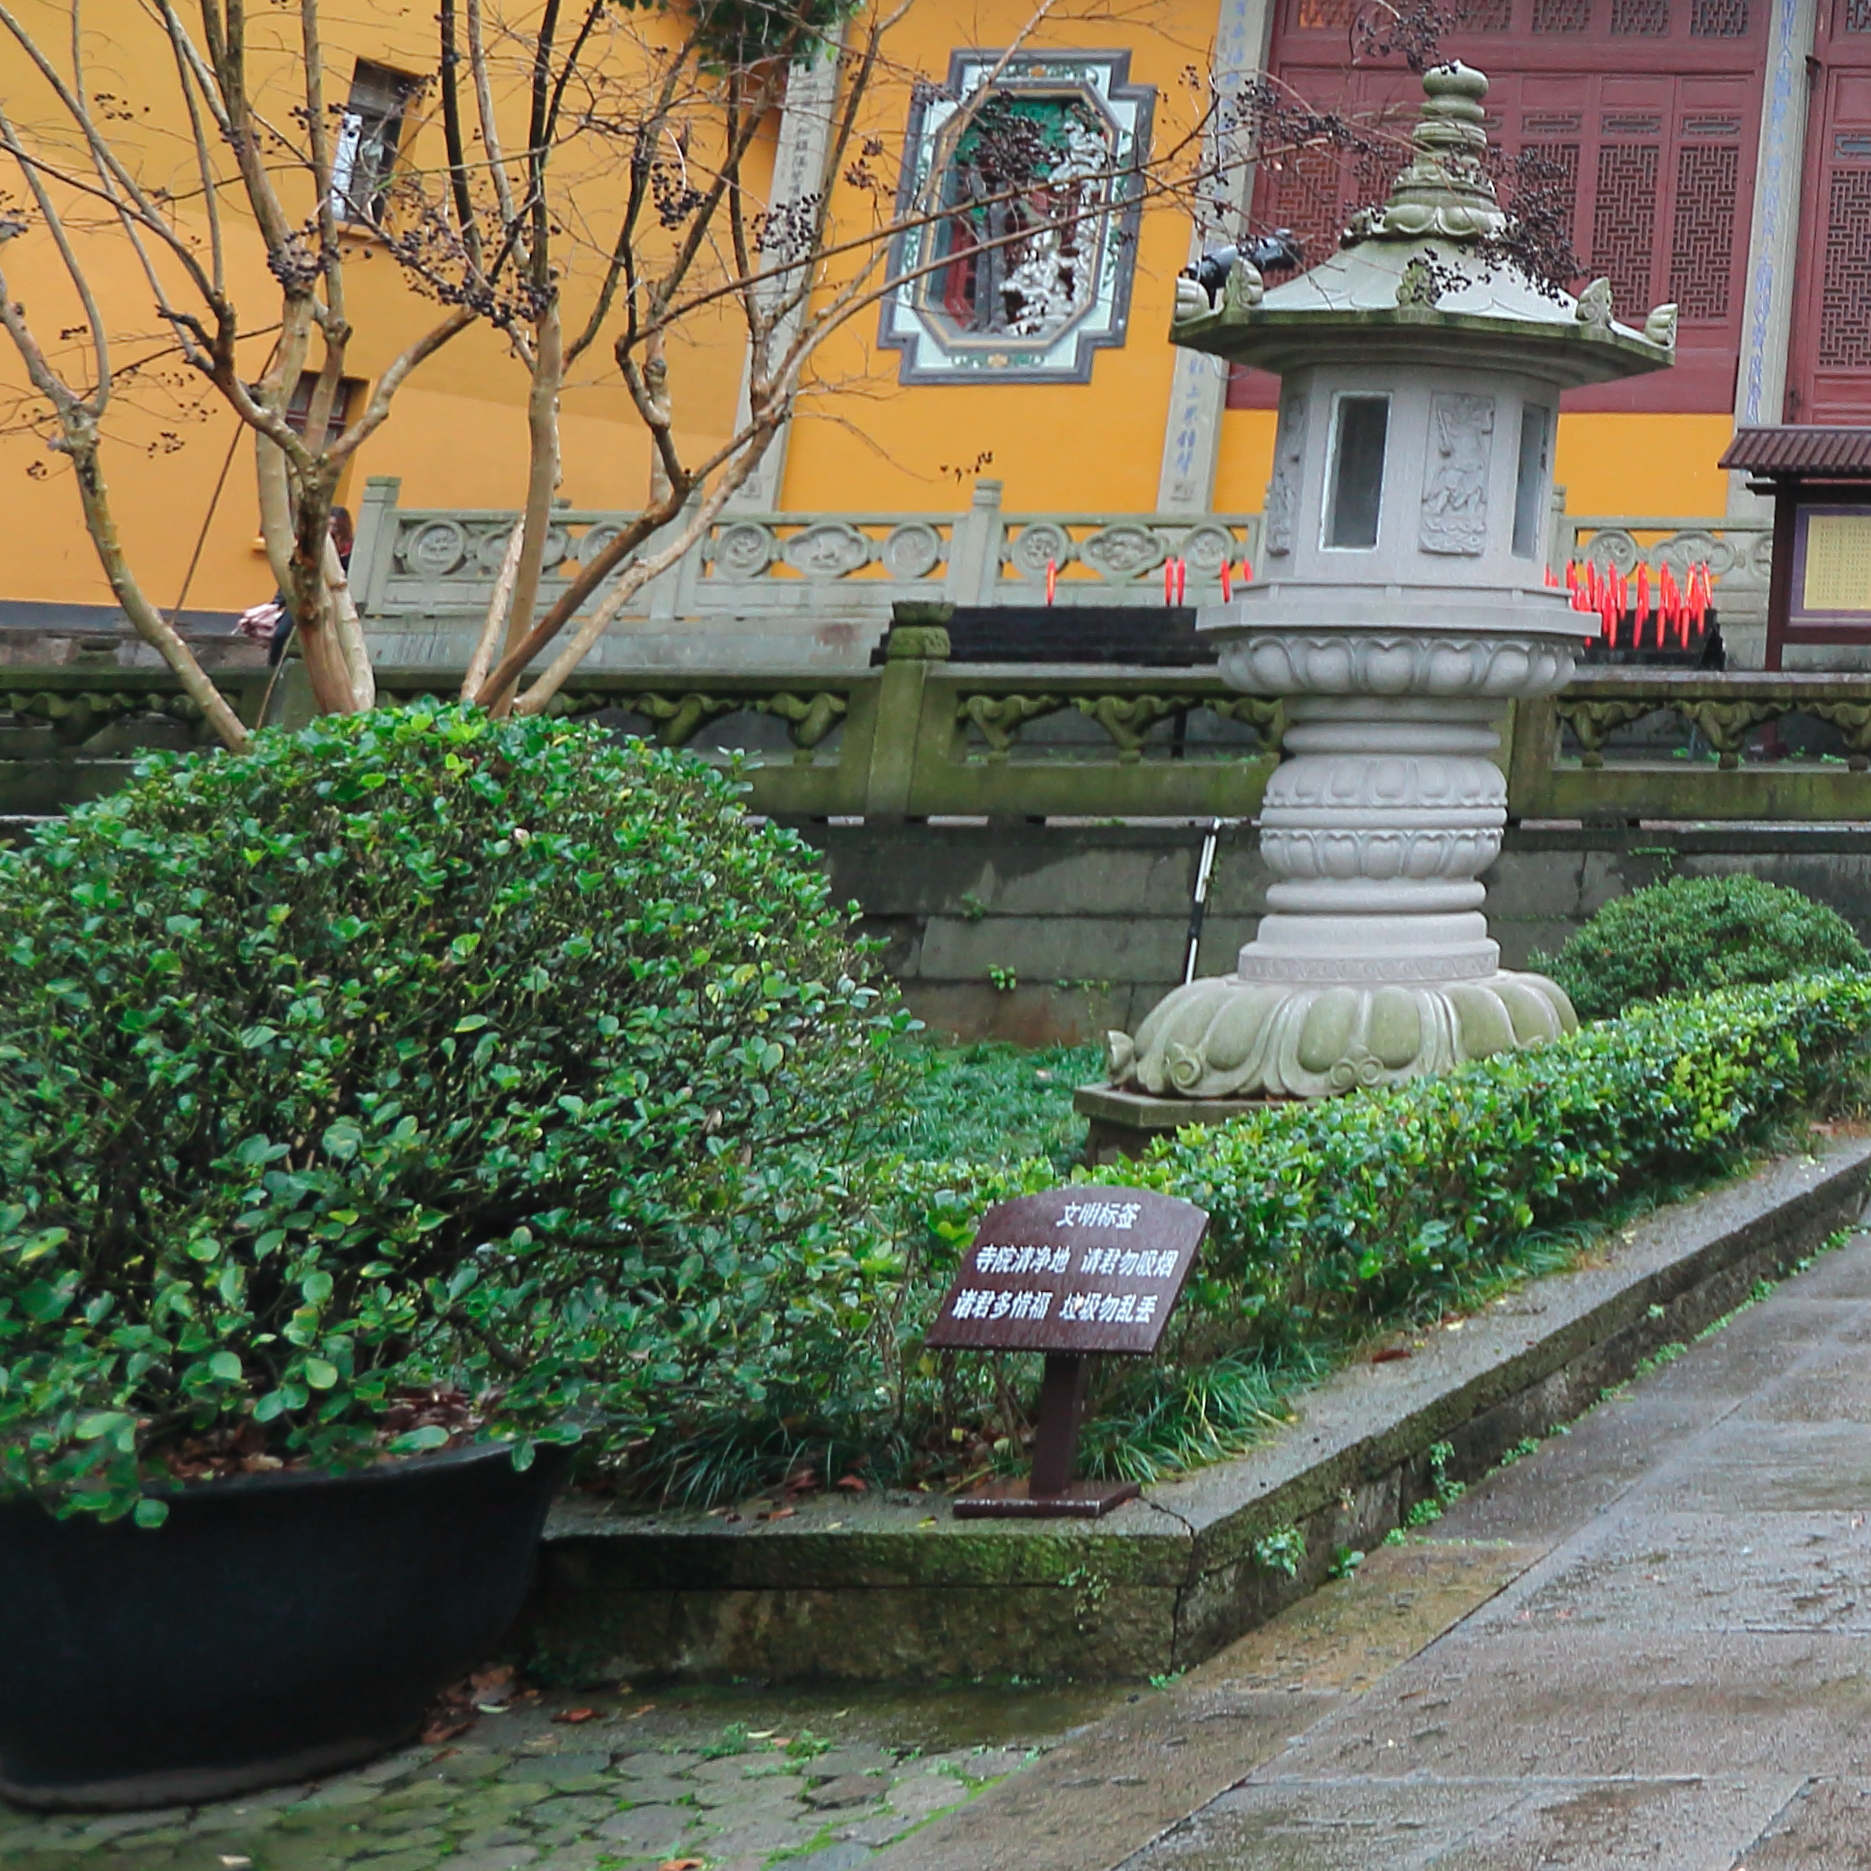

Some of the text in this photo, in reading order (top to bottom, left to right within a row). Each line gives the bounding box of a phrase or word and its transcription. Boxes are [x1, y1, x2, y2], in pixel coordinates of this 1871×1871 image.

[1056, 1201, 1142, 1230] 文明标签
[975, 1244, 1179, 1278] 寺院清净地 请君勿吸烟
[952, 1289, 1159, 1324] 诸君多惜福 垃圾勿乱丢
